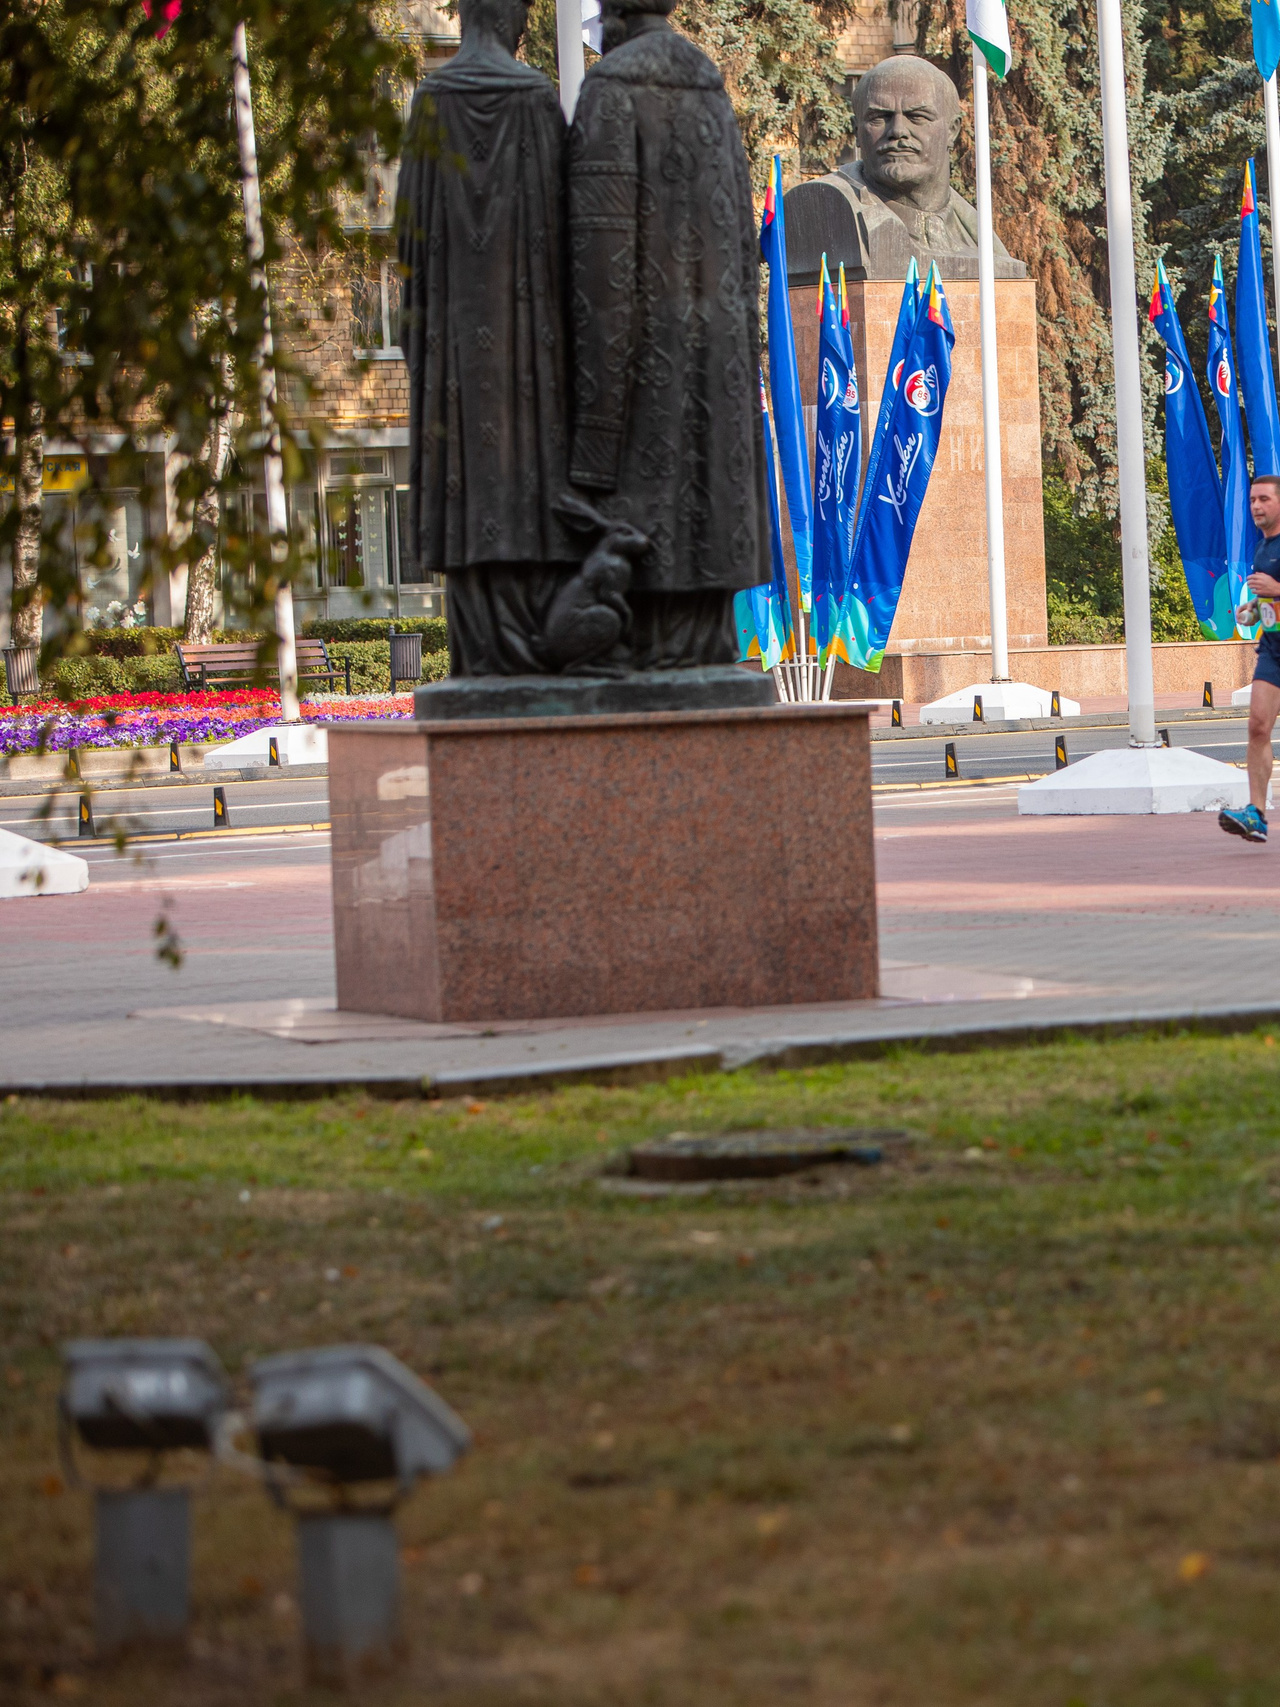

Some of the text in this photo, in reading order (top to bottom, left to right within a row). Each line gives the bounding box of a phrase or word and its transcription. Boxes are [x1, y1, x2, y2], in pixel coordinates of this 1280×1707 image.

[846, 388, 856, 399] 85
[917, 390, 928, 401] 85
[42, 462, 81, 472] СКАЯ
[878, 432, 923, 525] Химки
